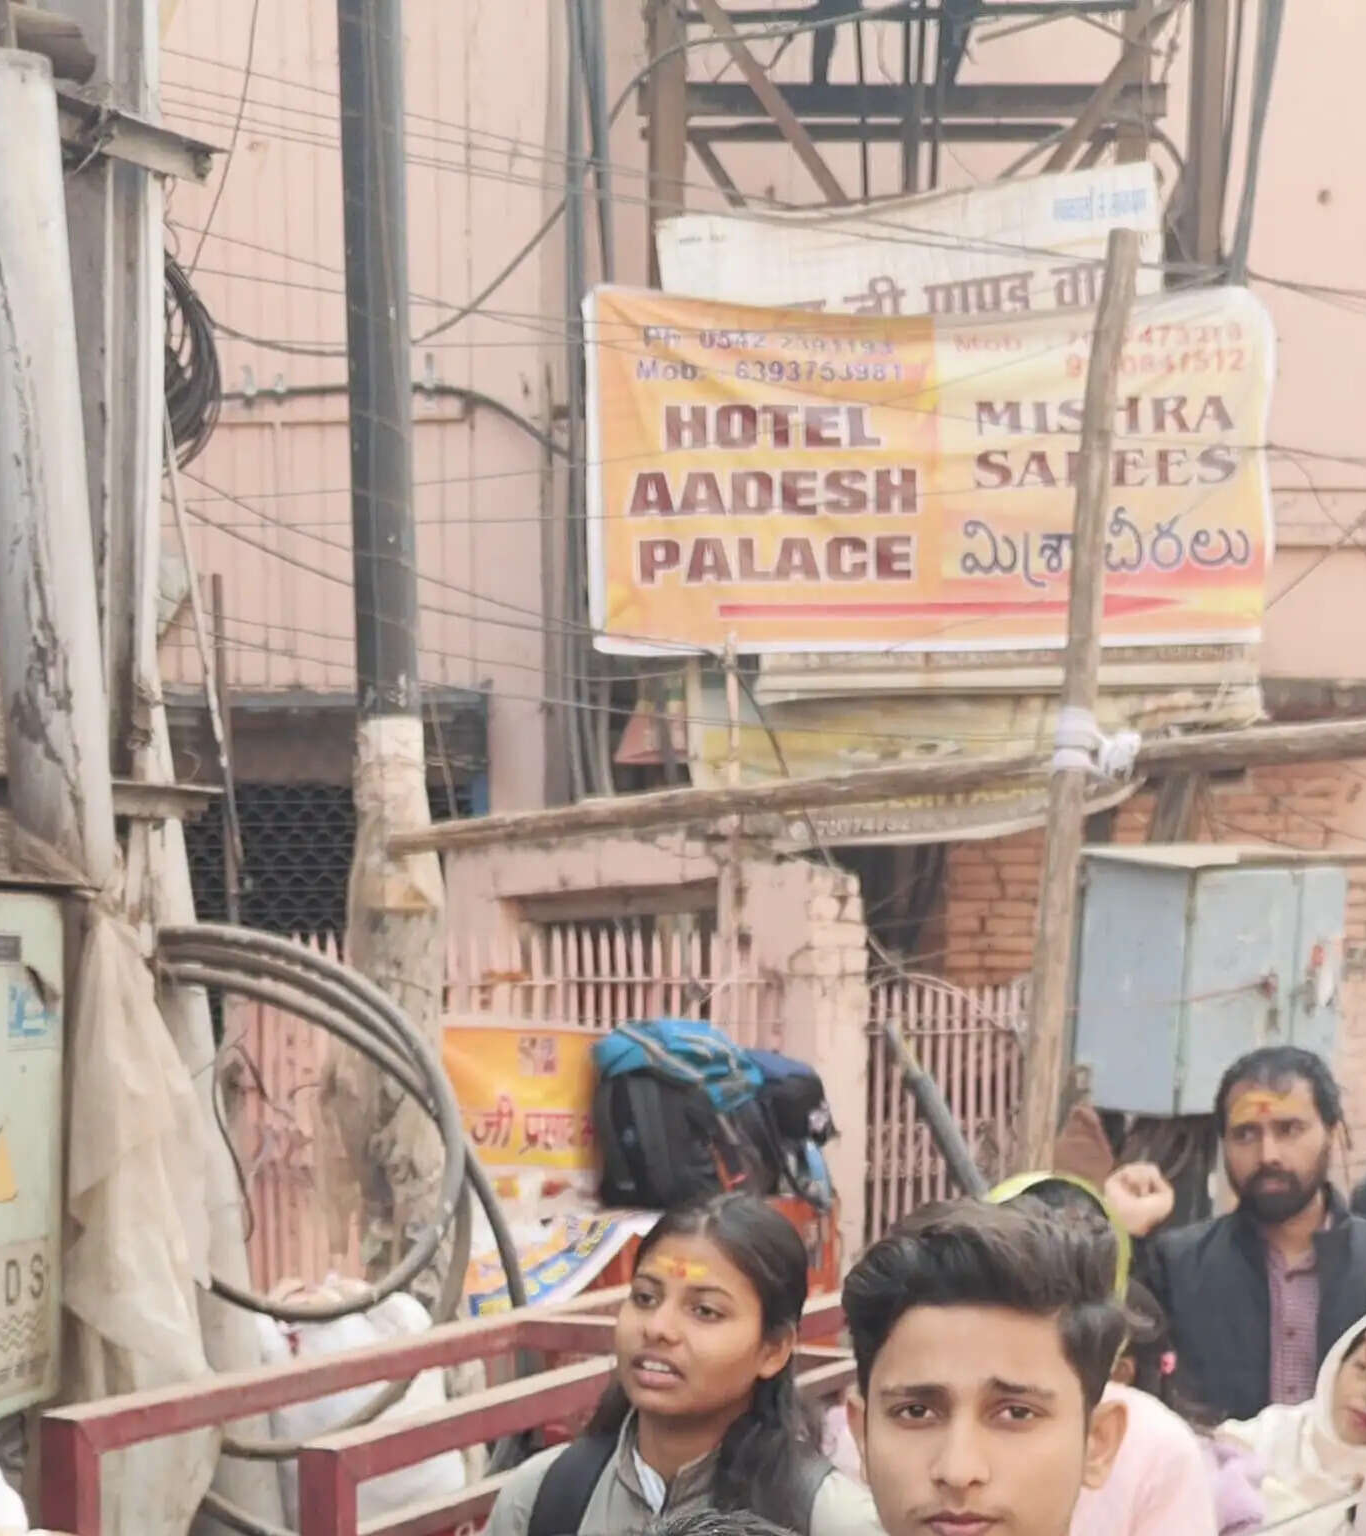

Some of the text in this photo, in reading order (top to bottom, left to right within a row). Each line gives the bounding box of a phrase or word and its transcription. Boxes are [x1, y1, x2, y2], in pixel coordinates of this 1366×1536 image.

[664, 403, 883, 451] HOTEL
[628, 467, 919, 518] AADESH
[636, 535, 915, 586] PALACE
